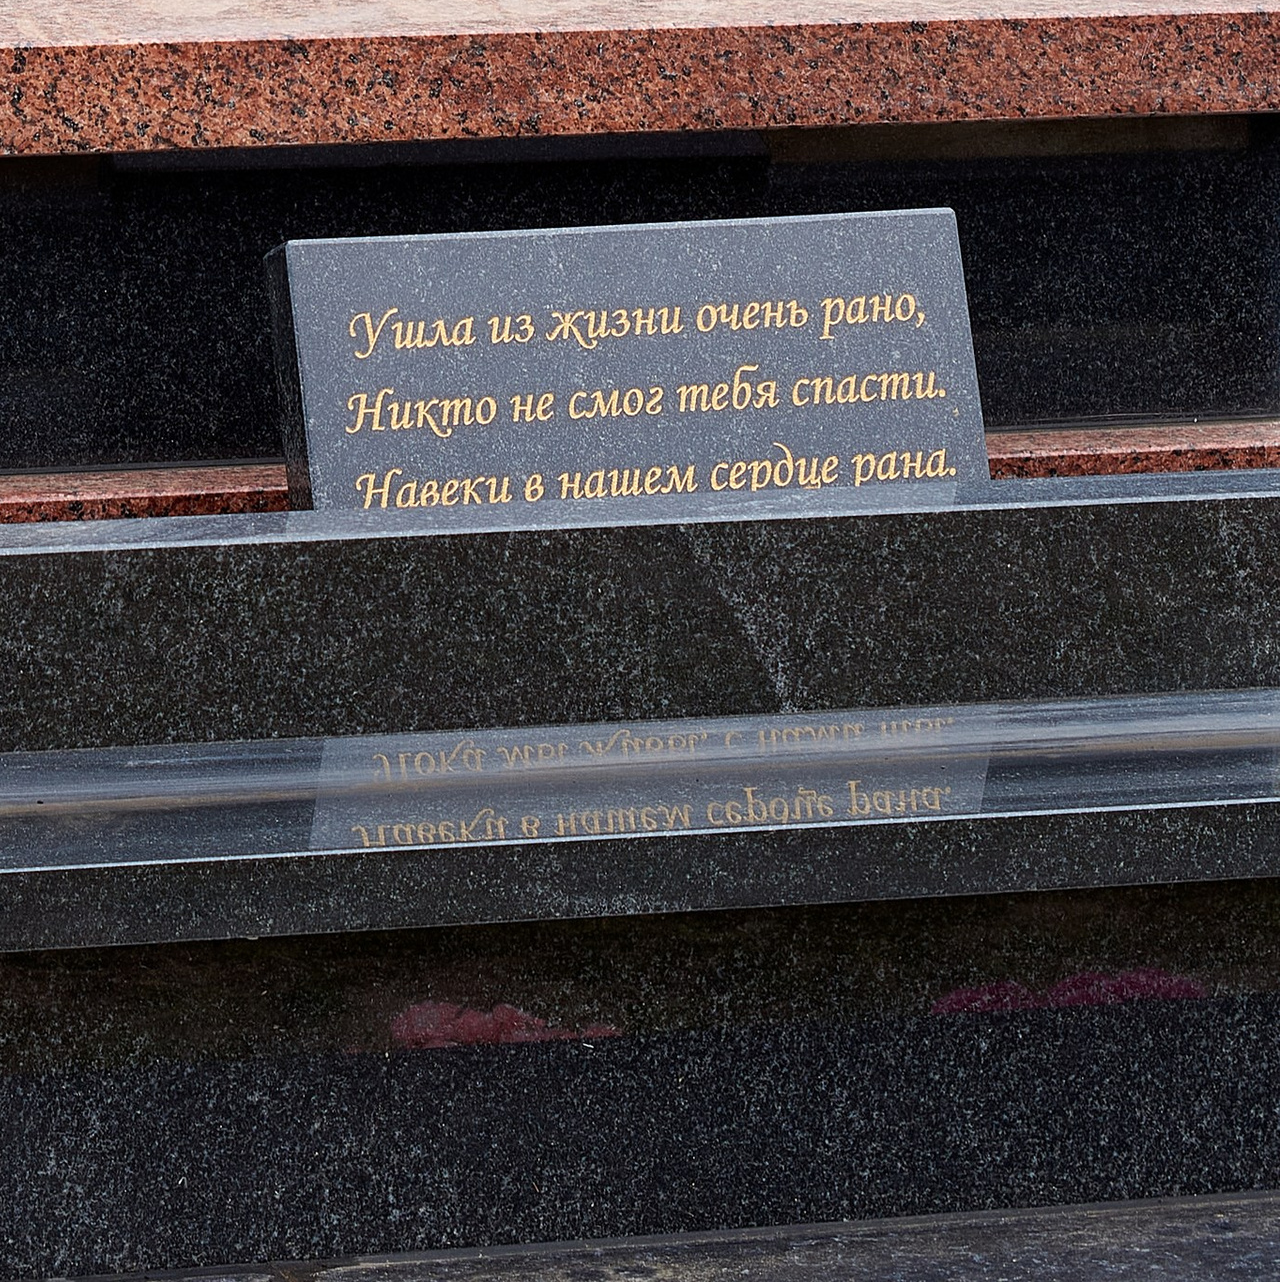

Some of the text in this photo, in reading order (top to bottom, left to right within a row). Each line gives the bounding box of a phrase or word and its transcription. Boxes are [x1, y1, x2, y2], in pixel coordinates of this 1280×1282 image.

[349, 293, 925, 359] Ушла из жизни очень рано,
[345, 364, 947, 438] Никто не смог тебя спасти.
[355, 441, 957, 510] Навеки в нашем сердце рана.
